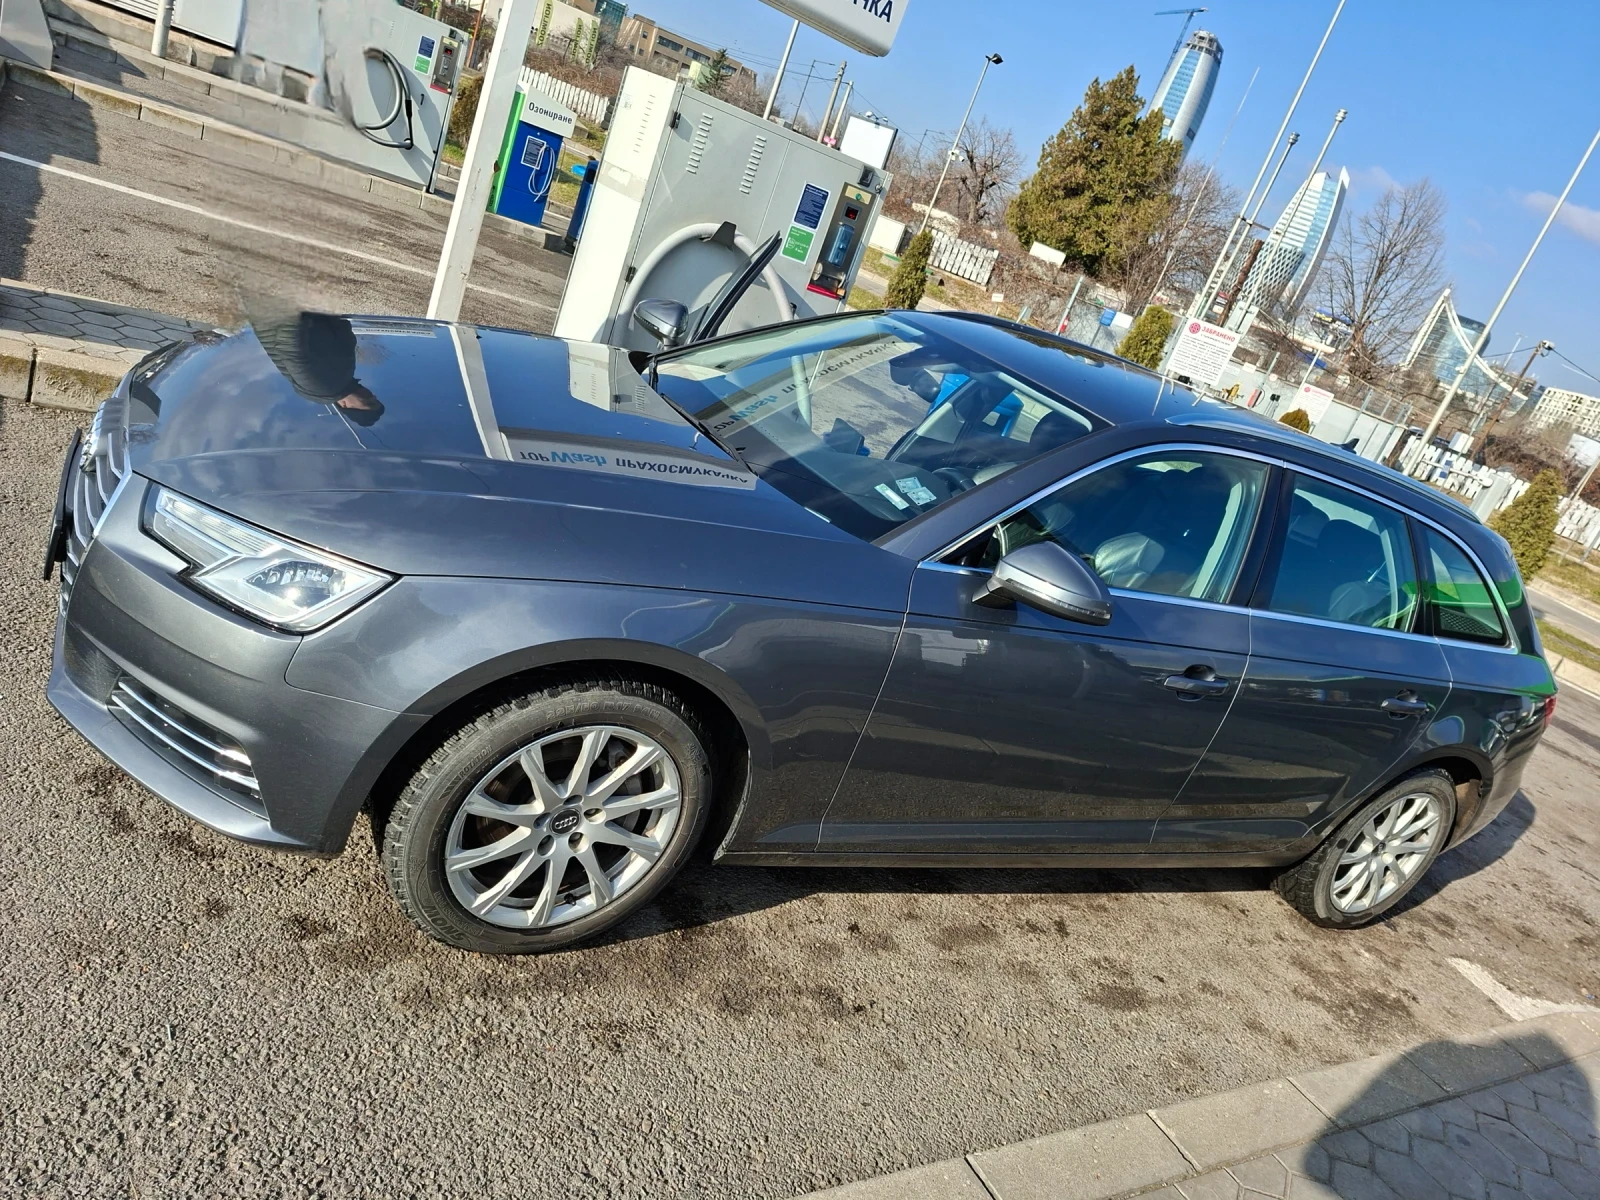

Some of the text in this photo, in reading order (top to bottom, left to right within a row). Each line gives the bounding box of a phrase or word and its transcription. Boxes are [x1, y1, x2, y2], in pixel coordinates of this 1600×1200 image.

[853, 0, 893, 23] КА
[528, 102, 573, 124] Озониране
[1201, 326, 1236, 343] ЗАБРАНЕНО
[460, 745, 493, 779] ROTATION
[422, 905, 465, 940] SNOW
